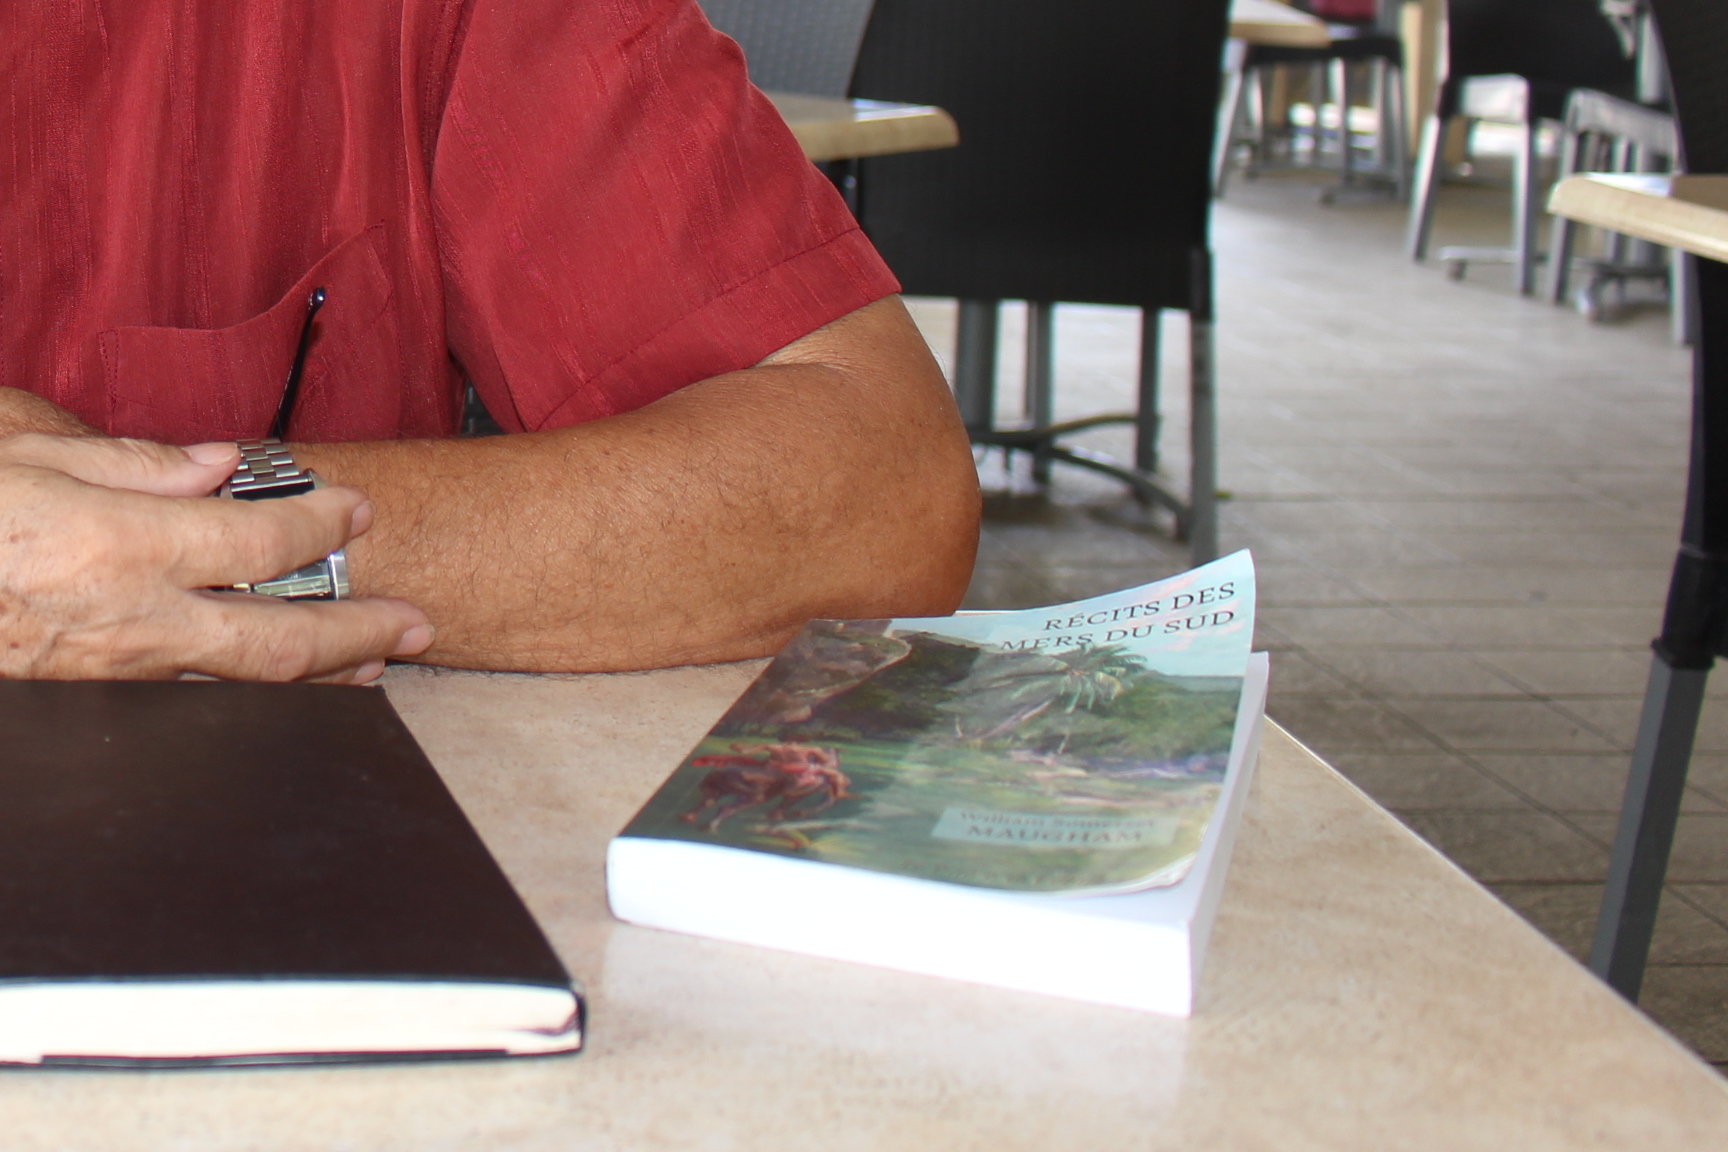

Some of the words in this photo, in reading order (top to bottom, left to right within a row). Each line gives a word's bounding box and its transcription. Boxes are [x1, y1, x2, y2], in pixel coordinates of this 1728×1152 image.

[1042, 600, 1160, 631] RÉCITS
[1172, 582, 1235, 610] DES
[1000, 633, 1094, 650] MERS
[1105, 624, 1155, 642] DU
[1163, 610, 1235, 635] SUD
[966, 825, 1142, 843] MAUGHAM
